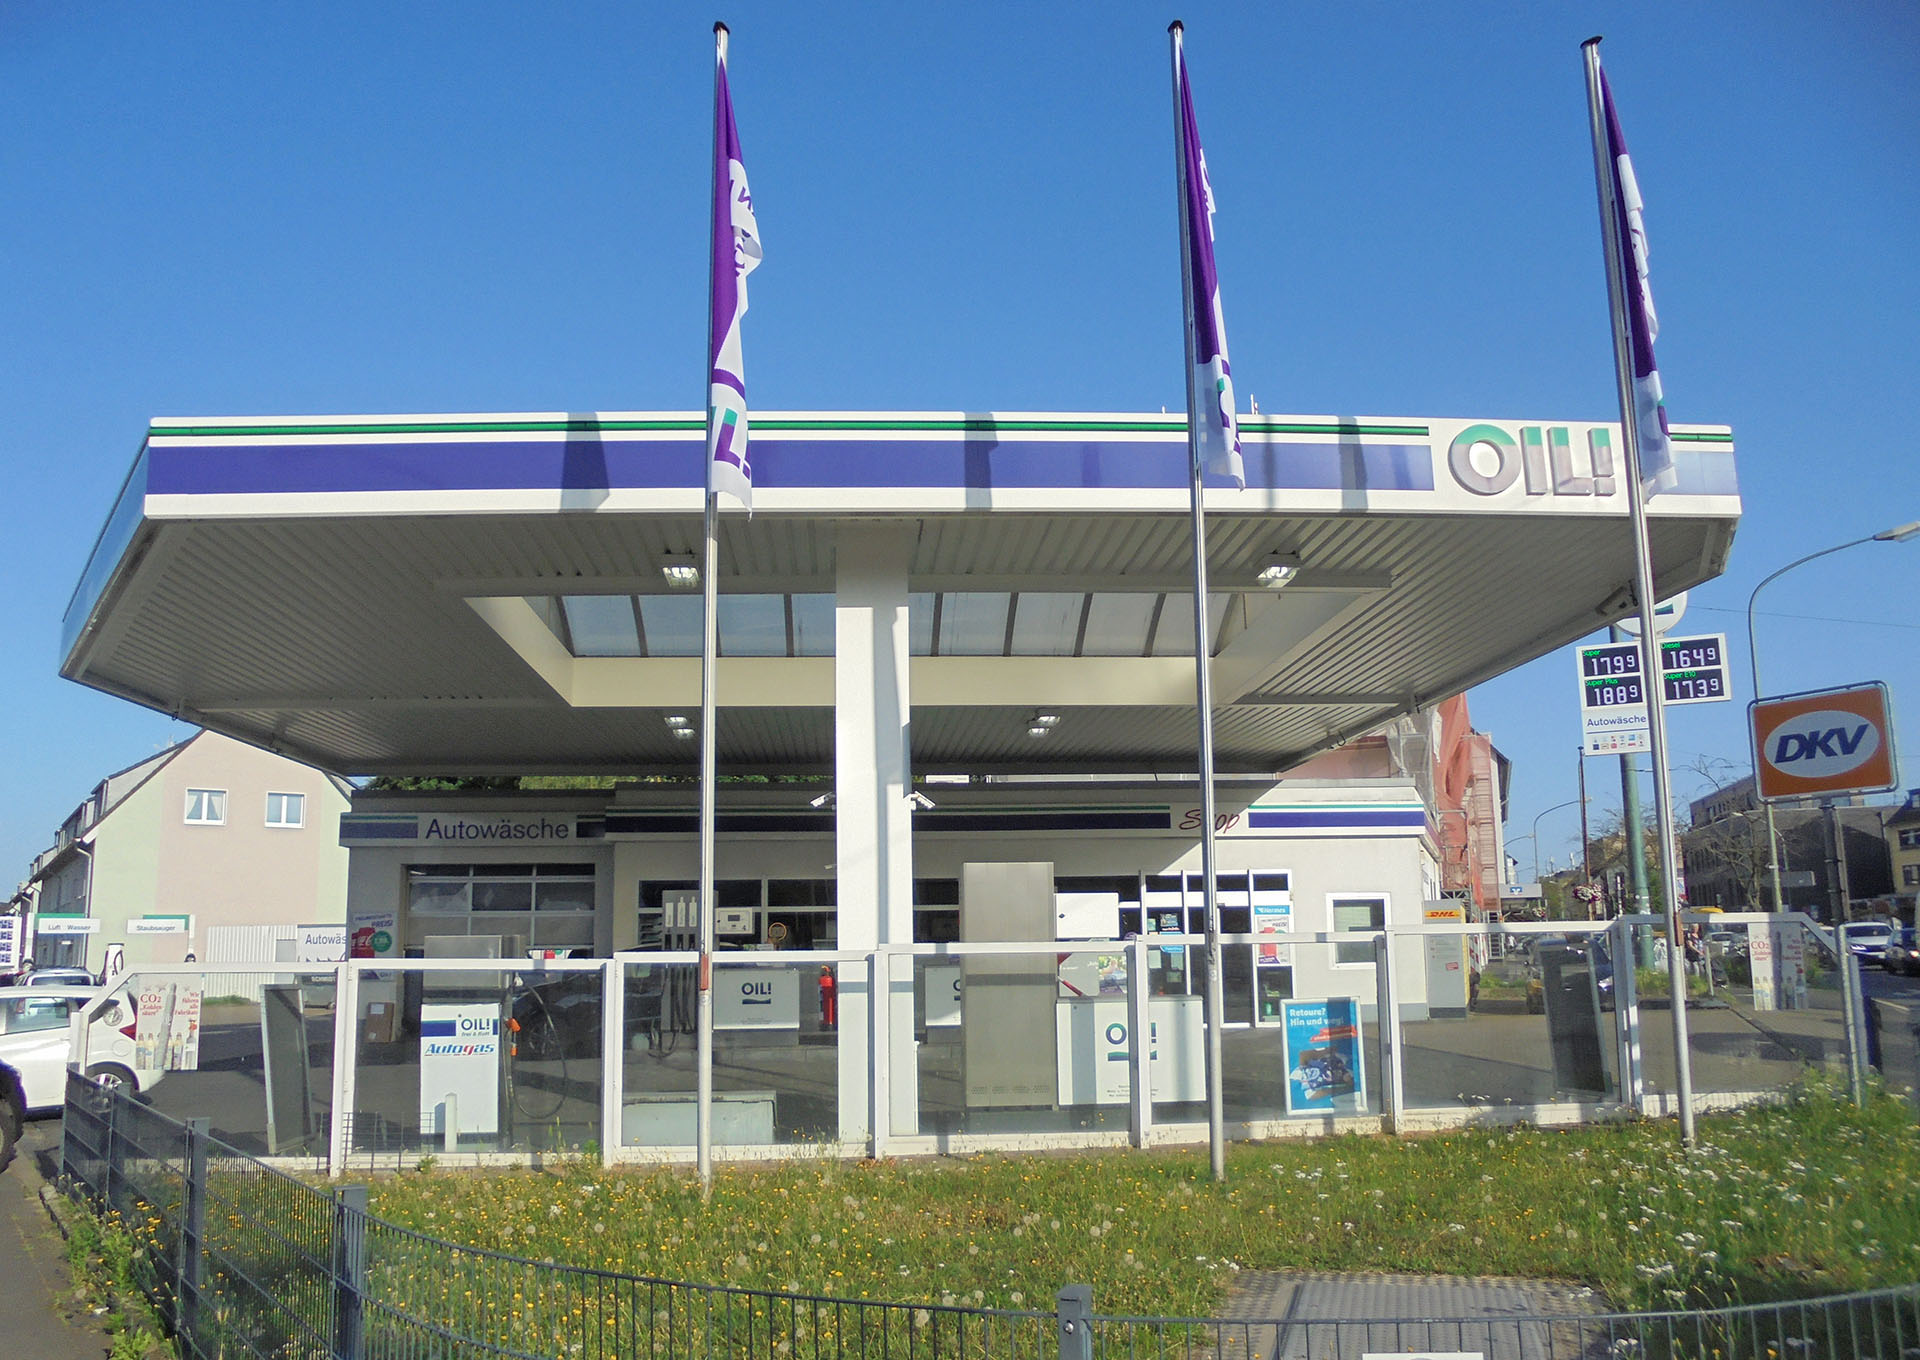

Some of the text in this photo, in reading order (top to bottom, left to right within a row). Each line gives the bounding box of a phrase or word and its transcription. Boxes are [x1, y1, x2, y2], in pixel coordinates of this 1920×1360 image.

[1448, 424, 1616, 496] OIL!
[1586, 715, 1647, 727] Autowäsche
[1774, 723, 1869, 763] DKV
[1179, 809, 1240, 834] Sop
[425, 818, 569, 839] Autowäsche
[305, 933, 346, 945] Autowäs
[741, 982, 772, 996] OIL!
[1289, 1008, 1326, 1017] Retoure?
[461, 1018, 490, 1031] OIL!
[1290, 1018, 1305, 1026] Hin
[1306, 1017, 1323, 1025] und
[1106, 1022, 1157, 1047] O!
[424, 1043, 496, 1055] Autogas
